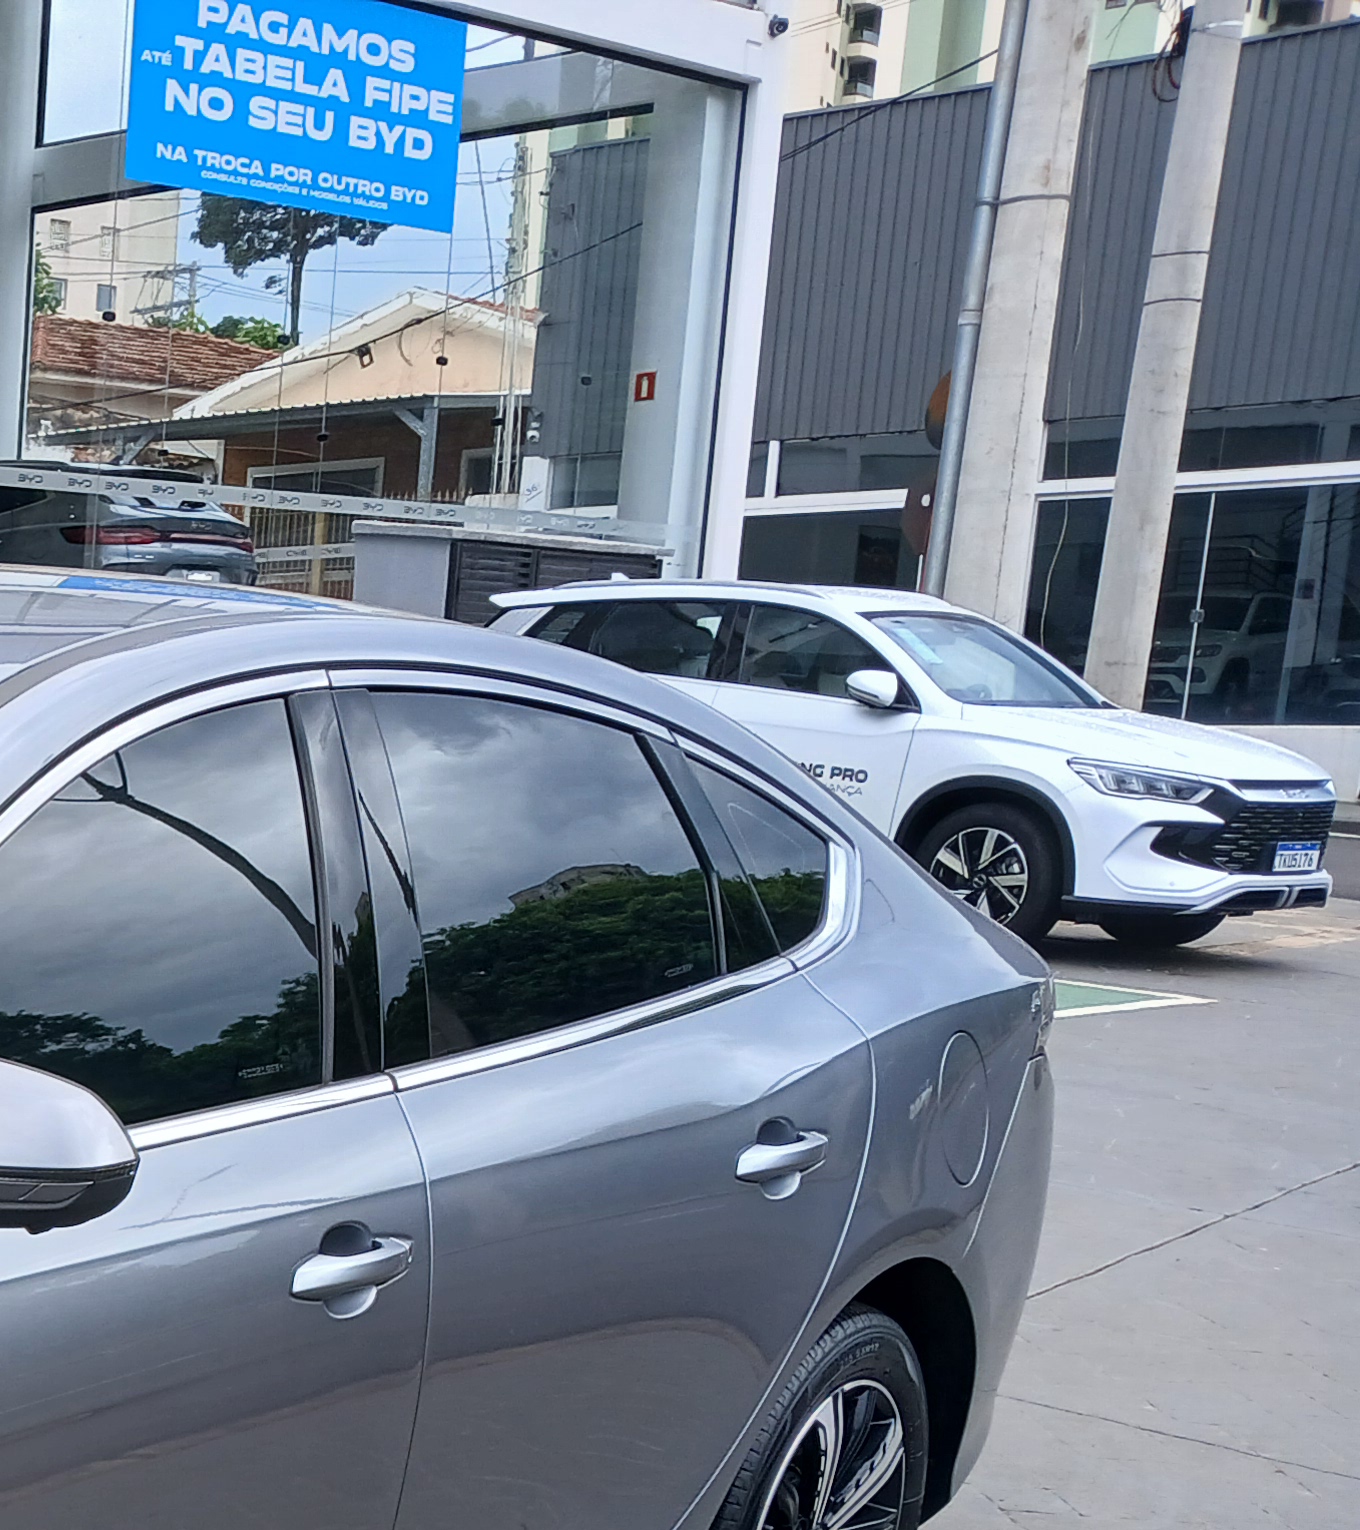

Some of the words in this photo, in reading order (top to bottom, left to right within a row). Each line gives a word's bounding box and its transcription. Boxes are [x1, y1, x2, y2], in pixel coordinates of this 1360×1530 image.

[197, 0, 416, 73] PAGAMOS
[141, 49, 172, 66] ATÉ
[174, 35, 351, 103] TABELA
[363, 76, 456, 124] FIPE
[164, 78, 234, 121] NO
[247, 95, 335, 142] SEU
[348, 115, 433, 160] BYD
[156, 142, 188, 163] NA
[193, 149, 264, 177] TROCA
[270, 163, 312, 184] POR
[317, 172, 385, 197] OUTRO
[390, 186, 429, 206] BYD
[201, 170, 248, 186] CONSULTE
[310, 189, 351, 204] MODELOS
[17, 473, 43, 484] BYD
[67, 477, 92, 488] BYD
[105, 481, 129, 492] BYD
[151, 484, 176, 495] BYD
[830, 766, 868, 783] PRO
